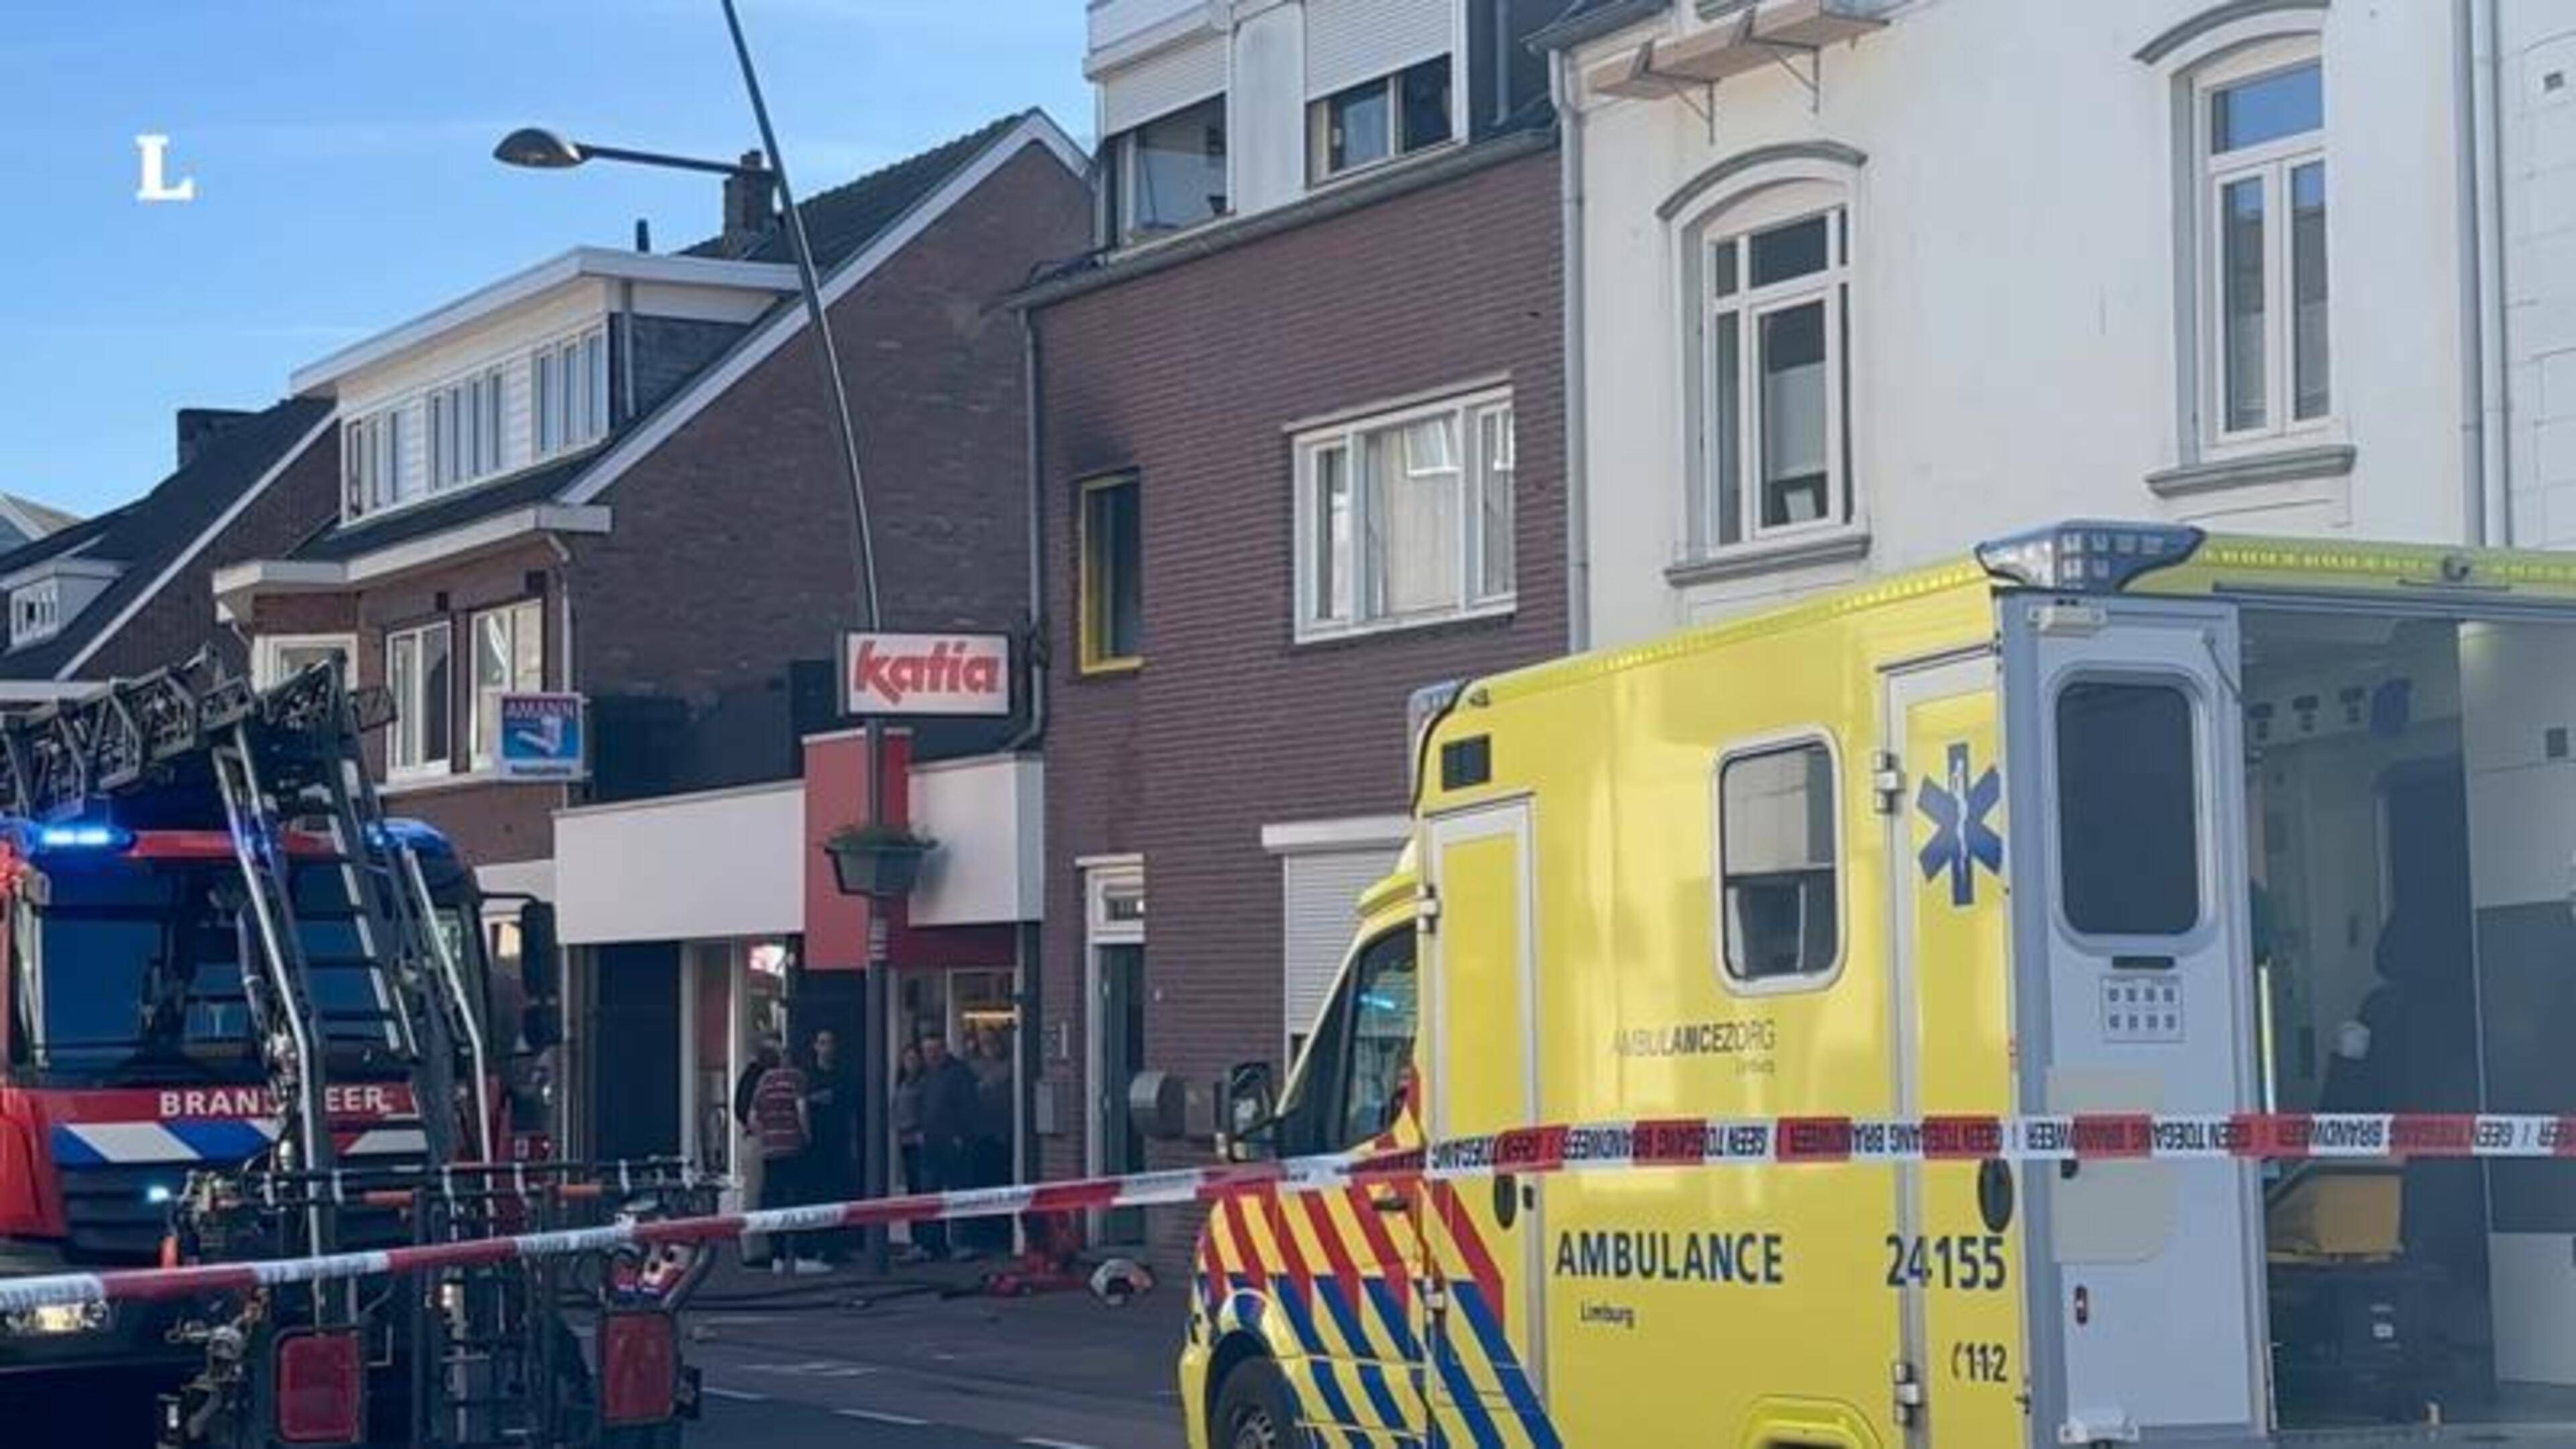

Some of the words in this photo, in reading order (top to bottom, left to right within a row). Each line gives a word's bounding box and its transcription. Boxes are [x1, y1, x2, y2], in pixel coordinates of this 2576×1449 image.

[855, 639, 1000, 704] katia
[160, 1087, 384, 1116] BRANEER
[1555, 1231, 1783, 1284] AMBULANCE
[1886, 1234, 2006, 1289] 24155
